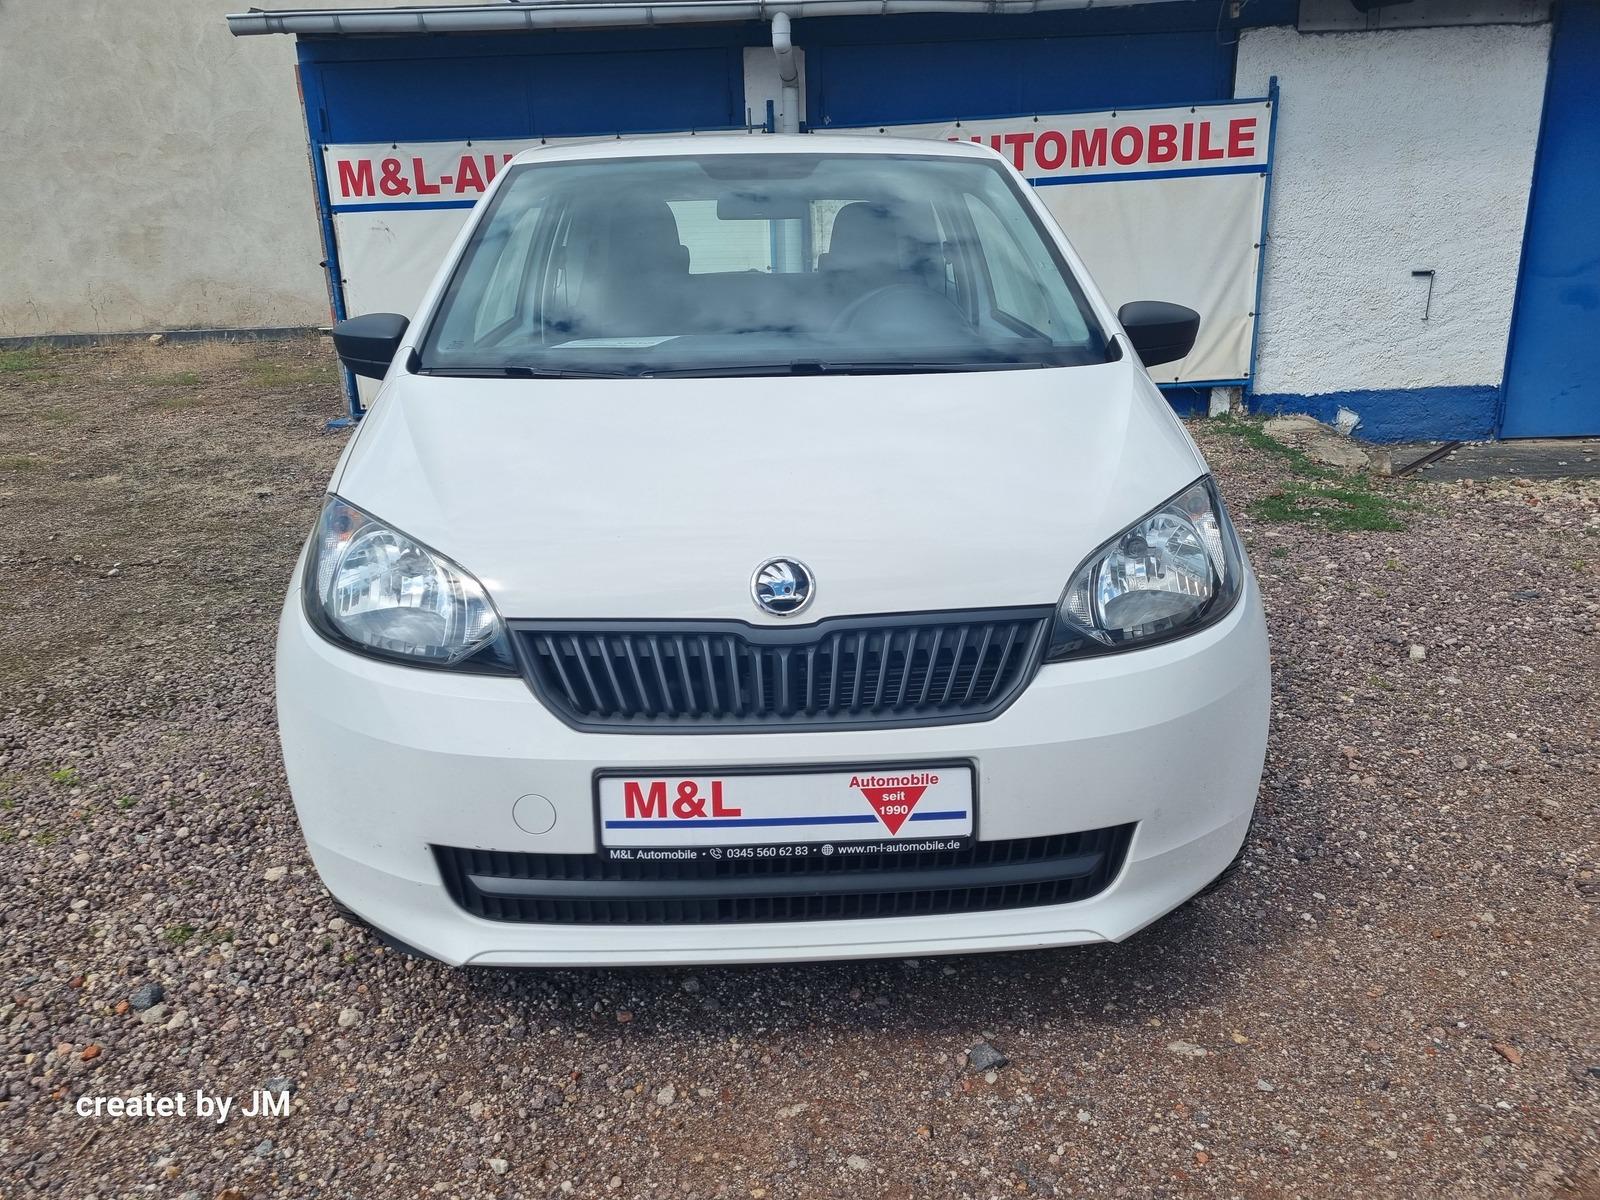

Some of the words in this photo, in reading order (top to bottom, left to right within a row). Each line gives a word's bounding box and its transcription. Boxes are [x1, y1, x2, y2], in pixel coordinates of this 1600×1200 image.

[947, 117, 1257, 172] TOMOBILE
[849, 773, 939, 788] Automobile
[623, 780, 742, 820] M&L
[881, 791, 906, 801] seit
[879, 804, 909, 815] 1990
[610, 850, 634, 860] M&L
[636, 849, 697, 860] Automobile
[726, 848, 754, 858] 0345
[756, 847, 777, 857] 560
[779, 846, 793, 856] 62
[794, 845, 809, 856] 83
[837, 840, 961, 855] www.m-l-automobile.de
